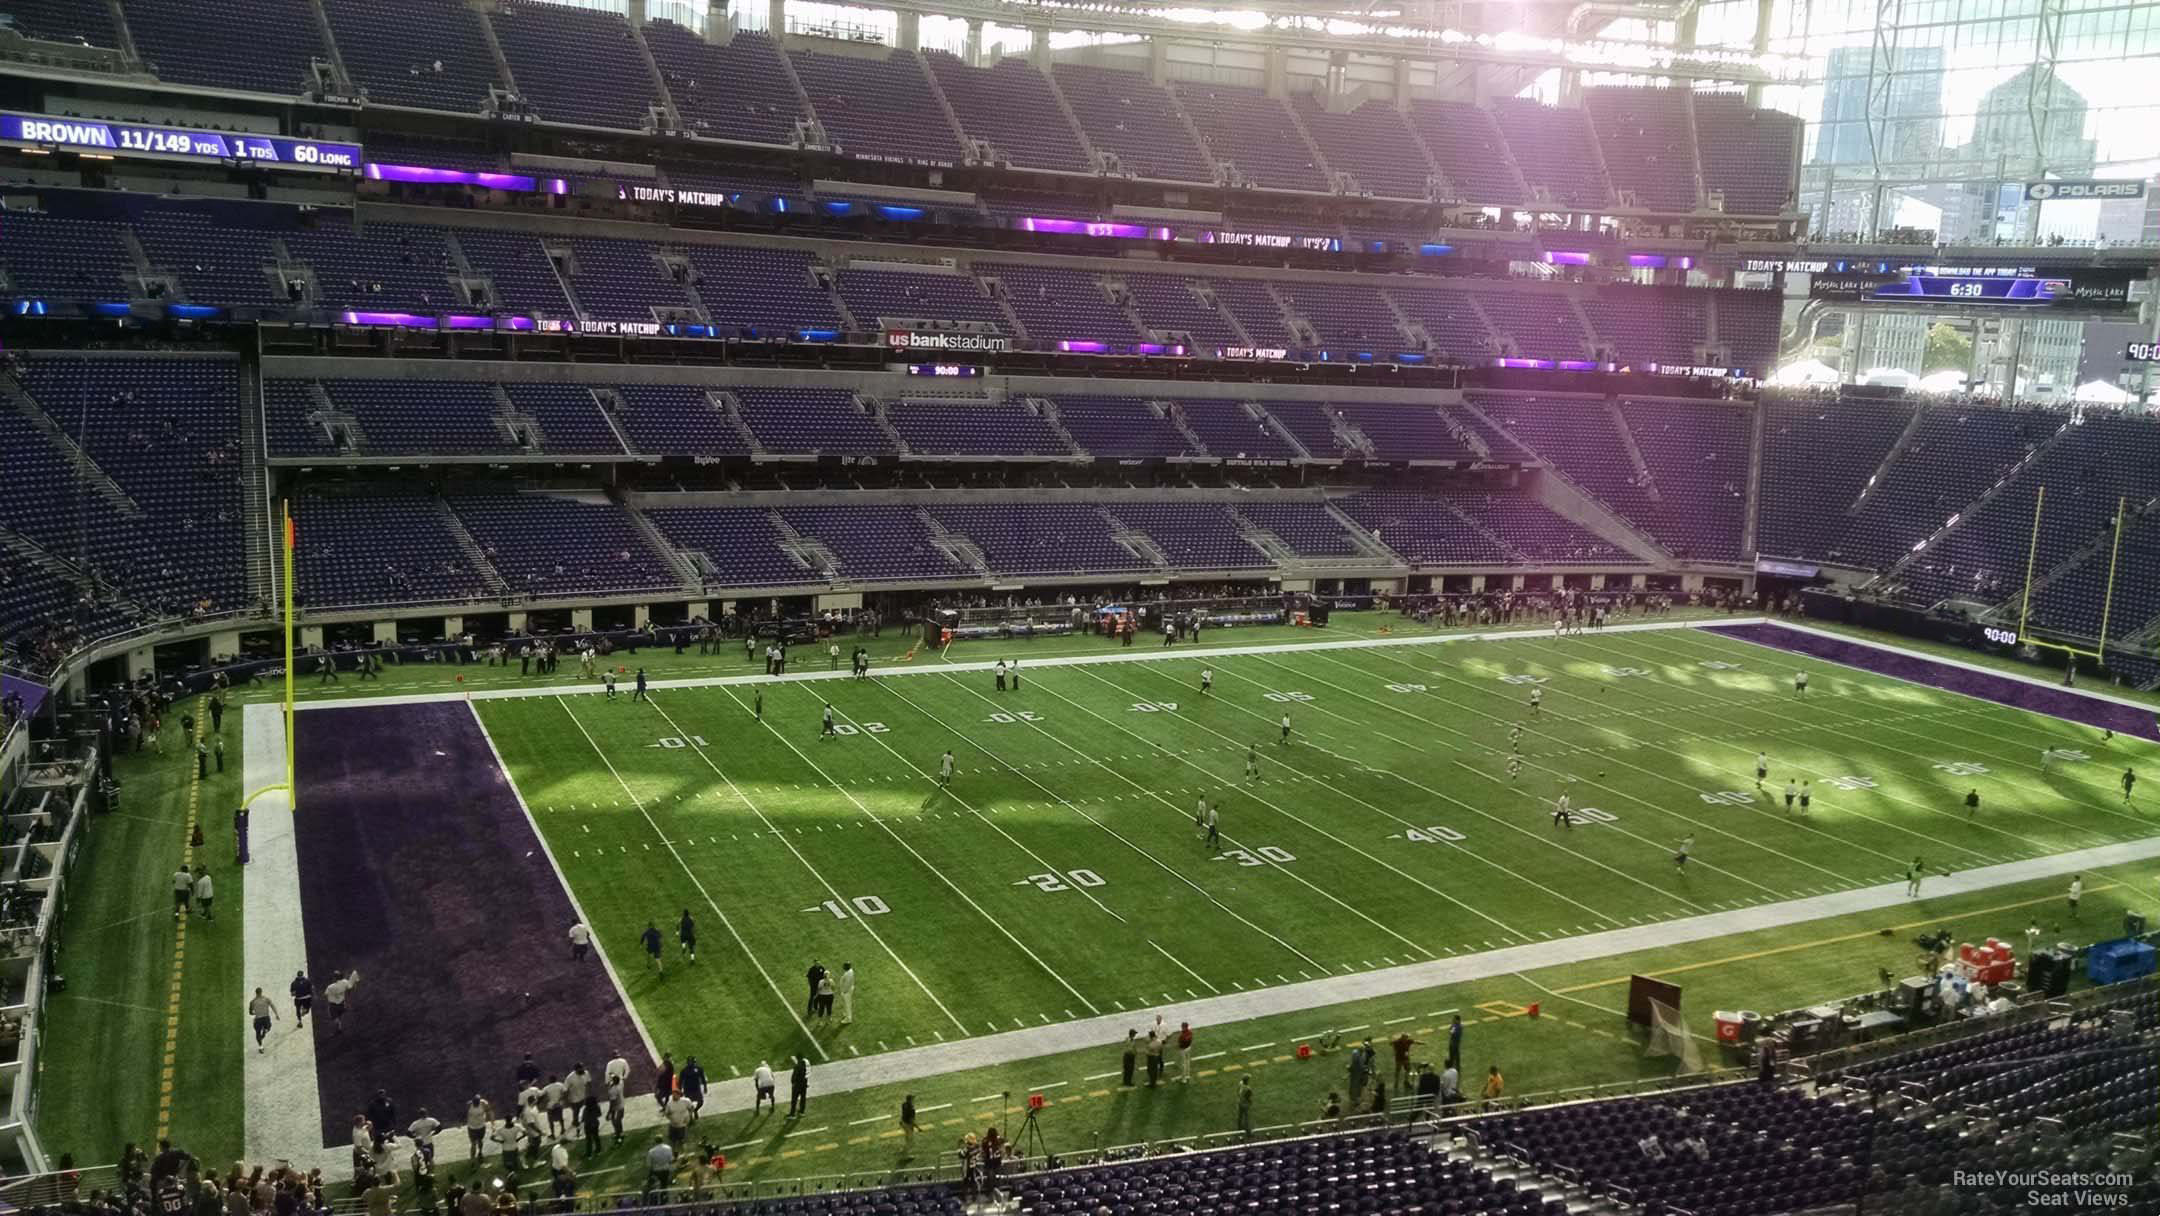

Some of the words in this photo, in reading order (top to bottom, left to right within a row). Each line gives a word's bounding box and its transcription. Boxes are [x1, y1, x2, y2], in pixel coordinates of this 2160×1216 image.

[22, 120, 107, 145] BROWN
[120, 130, 191, 152] 11/149
[195, 142, 219, 155] YDS
[235, 140, 248, 158] 1
[250, 146, 273, 159] TDS
[294, 145, 318, 163] 60
[319, 152, 352, 166] LONG
[633, 186, 675, 202] TODAY'S
[678, 190, 724, 207] MATCHUP
[2058, 183, 2139, 196] POLARIS
[1220, 231, 1253, 246] TODAY'S
[1255, 234, 1292, 248] MATCHUP
[1747, 260, 1784, 272] TODAY'S
[1786, 261, 1828, 273] MATCHUP
[1950, 283, 1983, 297] 6:30
[580, 320, 617, 333] TODAY'S
[620, 322, 660, 335] MATCHUP
[1226, 346, 1254, 358] TODAY'S
[1255, 348, 1287, 360] MATCHUP
[935, 366, 959, 375] 90:00
[1661, 365, 1690, 376] TODAY'S
[1692, 366, 1728, 377] MATCHUP
[1984, 627, 2017, 645] 90:00
[1406, 825, 1467, 844] 40
[1221, 846, 1298, 867] 30
[1027, 868, 1107, 893] 20
[821, 895, 892, 920] 10
[1722, 1025, 1735, 1037] G
